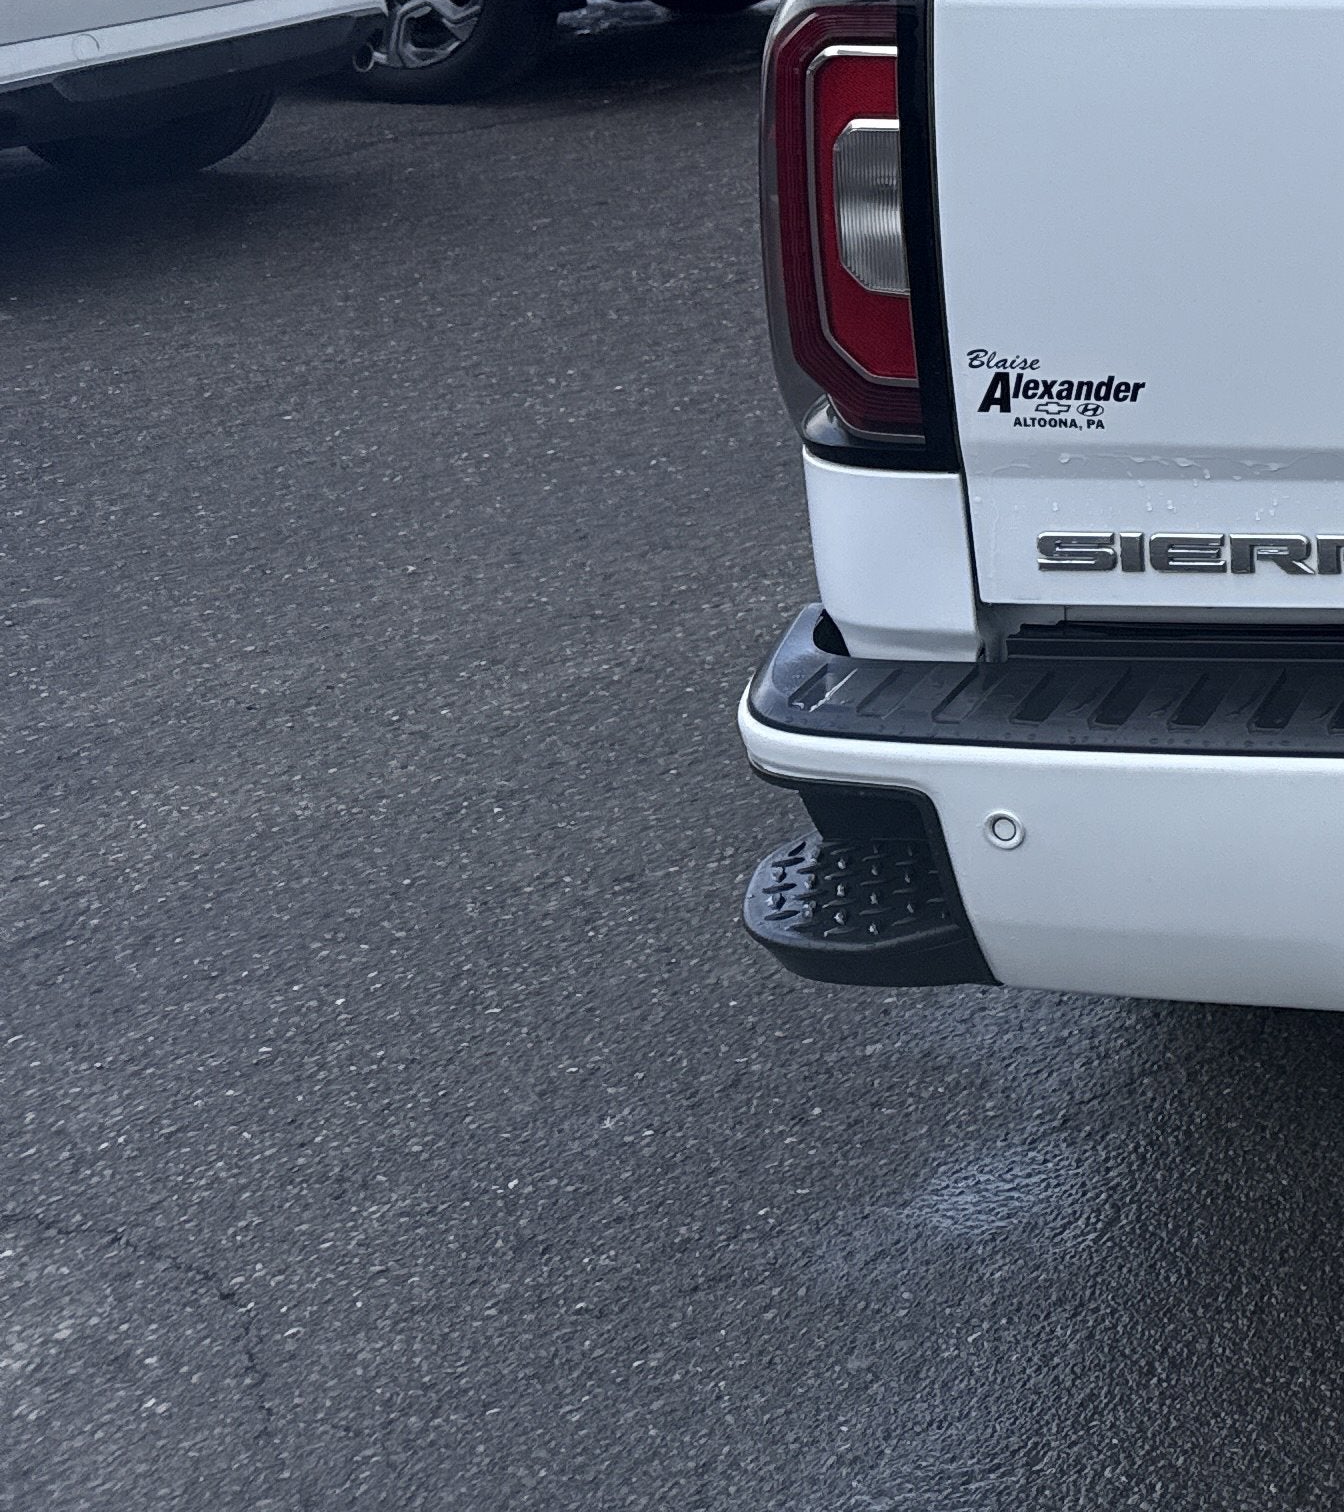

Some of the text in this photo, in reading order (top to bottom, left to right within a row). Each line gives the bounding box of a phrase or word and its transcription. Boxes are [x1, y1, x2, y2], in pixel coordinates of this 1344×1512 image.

[966, 348, 1041, 371] Blaise
[977, 371, 1146, 413] Alexander
[1013, 416, 1105, 431] ALTOONA, PA
